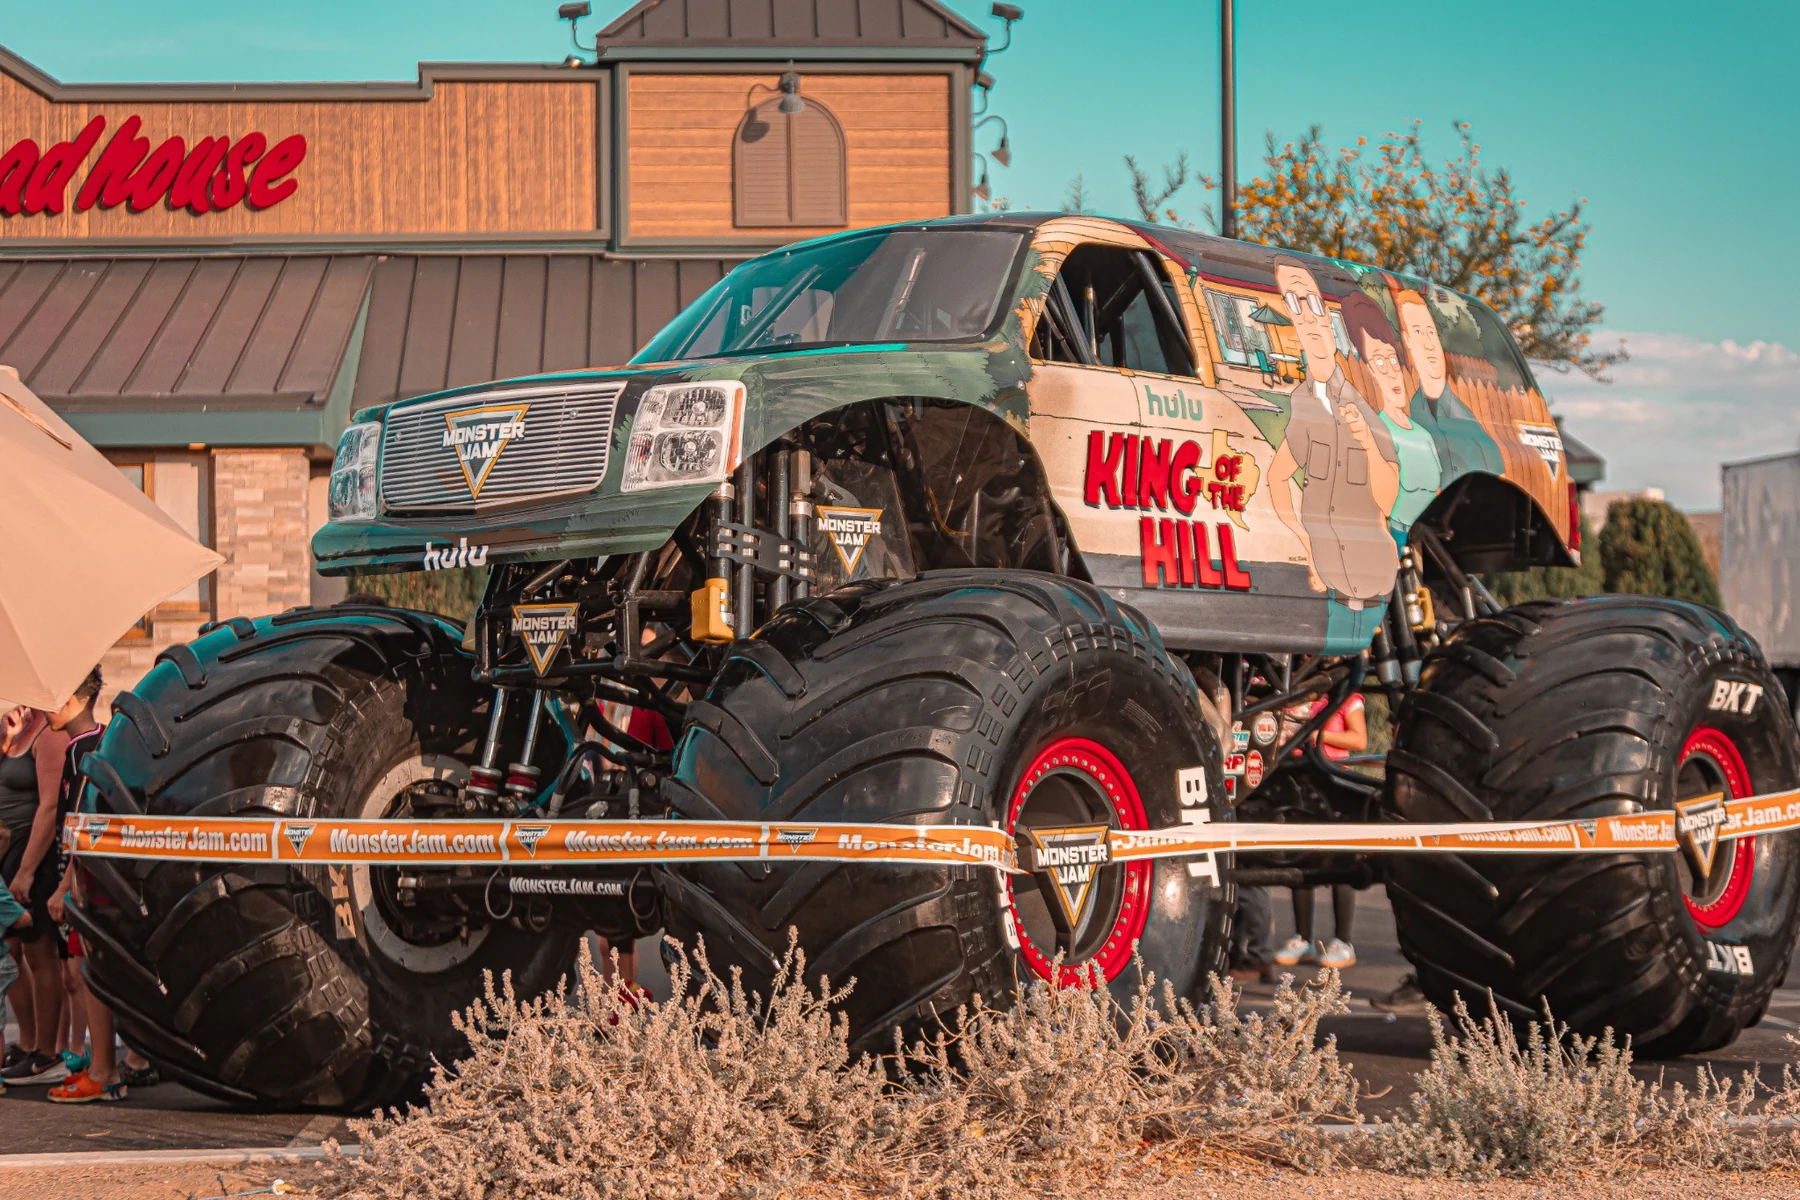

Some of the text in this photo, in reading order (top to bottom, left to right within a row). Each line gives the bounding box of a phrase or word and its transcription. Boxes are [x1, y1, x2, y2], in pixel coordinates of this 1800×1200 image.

[1144, 384, 1204, 421] hulu
[442, 421, 526, 447] MONSTER
[1518, 432, 1564, 451] MONSTE
[460, 441, 499, 461] JAM
[1083, 429, 1205, 517] KING
[1215, 453, 1244, 482] OF
[1208, 481, 1246, 512] THE
[818, 517, 882, 534] MONSTER
[835, 532, 864, 546] JAM
[423, 538, 489, 571] hulu
[1139, 515, 1253, 590] HILL
[511, 615, 576, 632] MONSTER
[529, 631, 559, 645] JAM
[1708, 679, 1764, 715] BKT
[1680, 807, 1727, 833] MONSTER
[120, 824, 268, 853] MonsterJam.com
[330, 828, 497, 854] MonsterJam.com
[1695, 825, 1716, 844] JAM
[1036, 843, 1109, 867] MONSTER
[1058, 864, 1091, 884] JAM
[327, 863, 357, 940] BK
[996, 866, 1021, 950] BK
[1706, 940, 1754, 976] BKT
